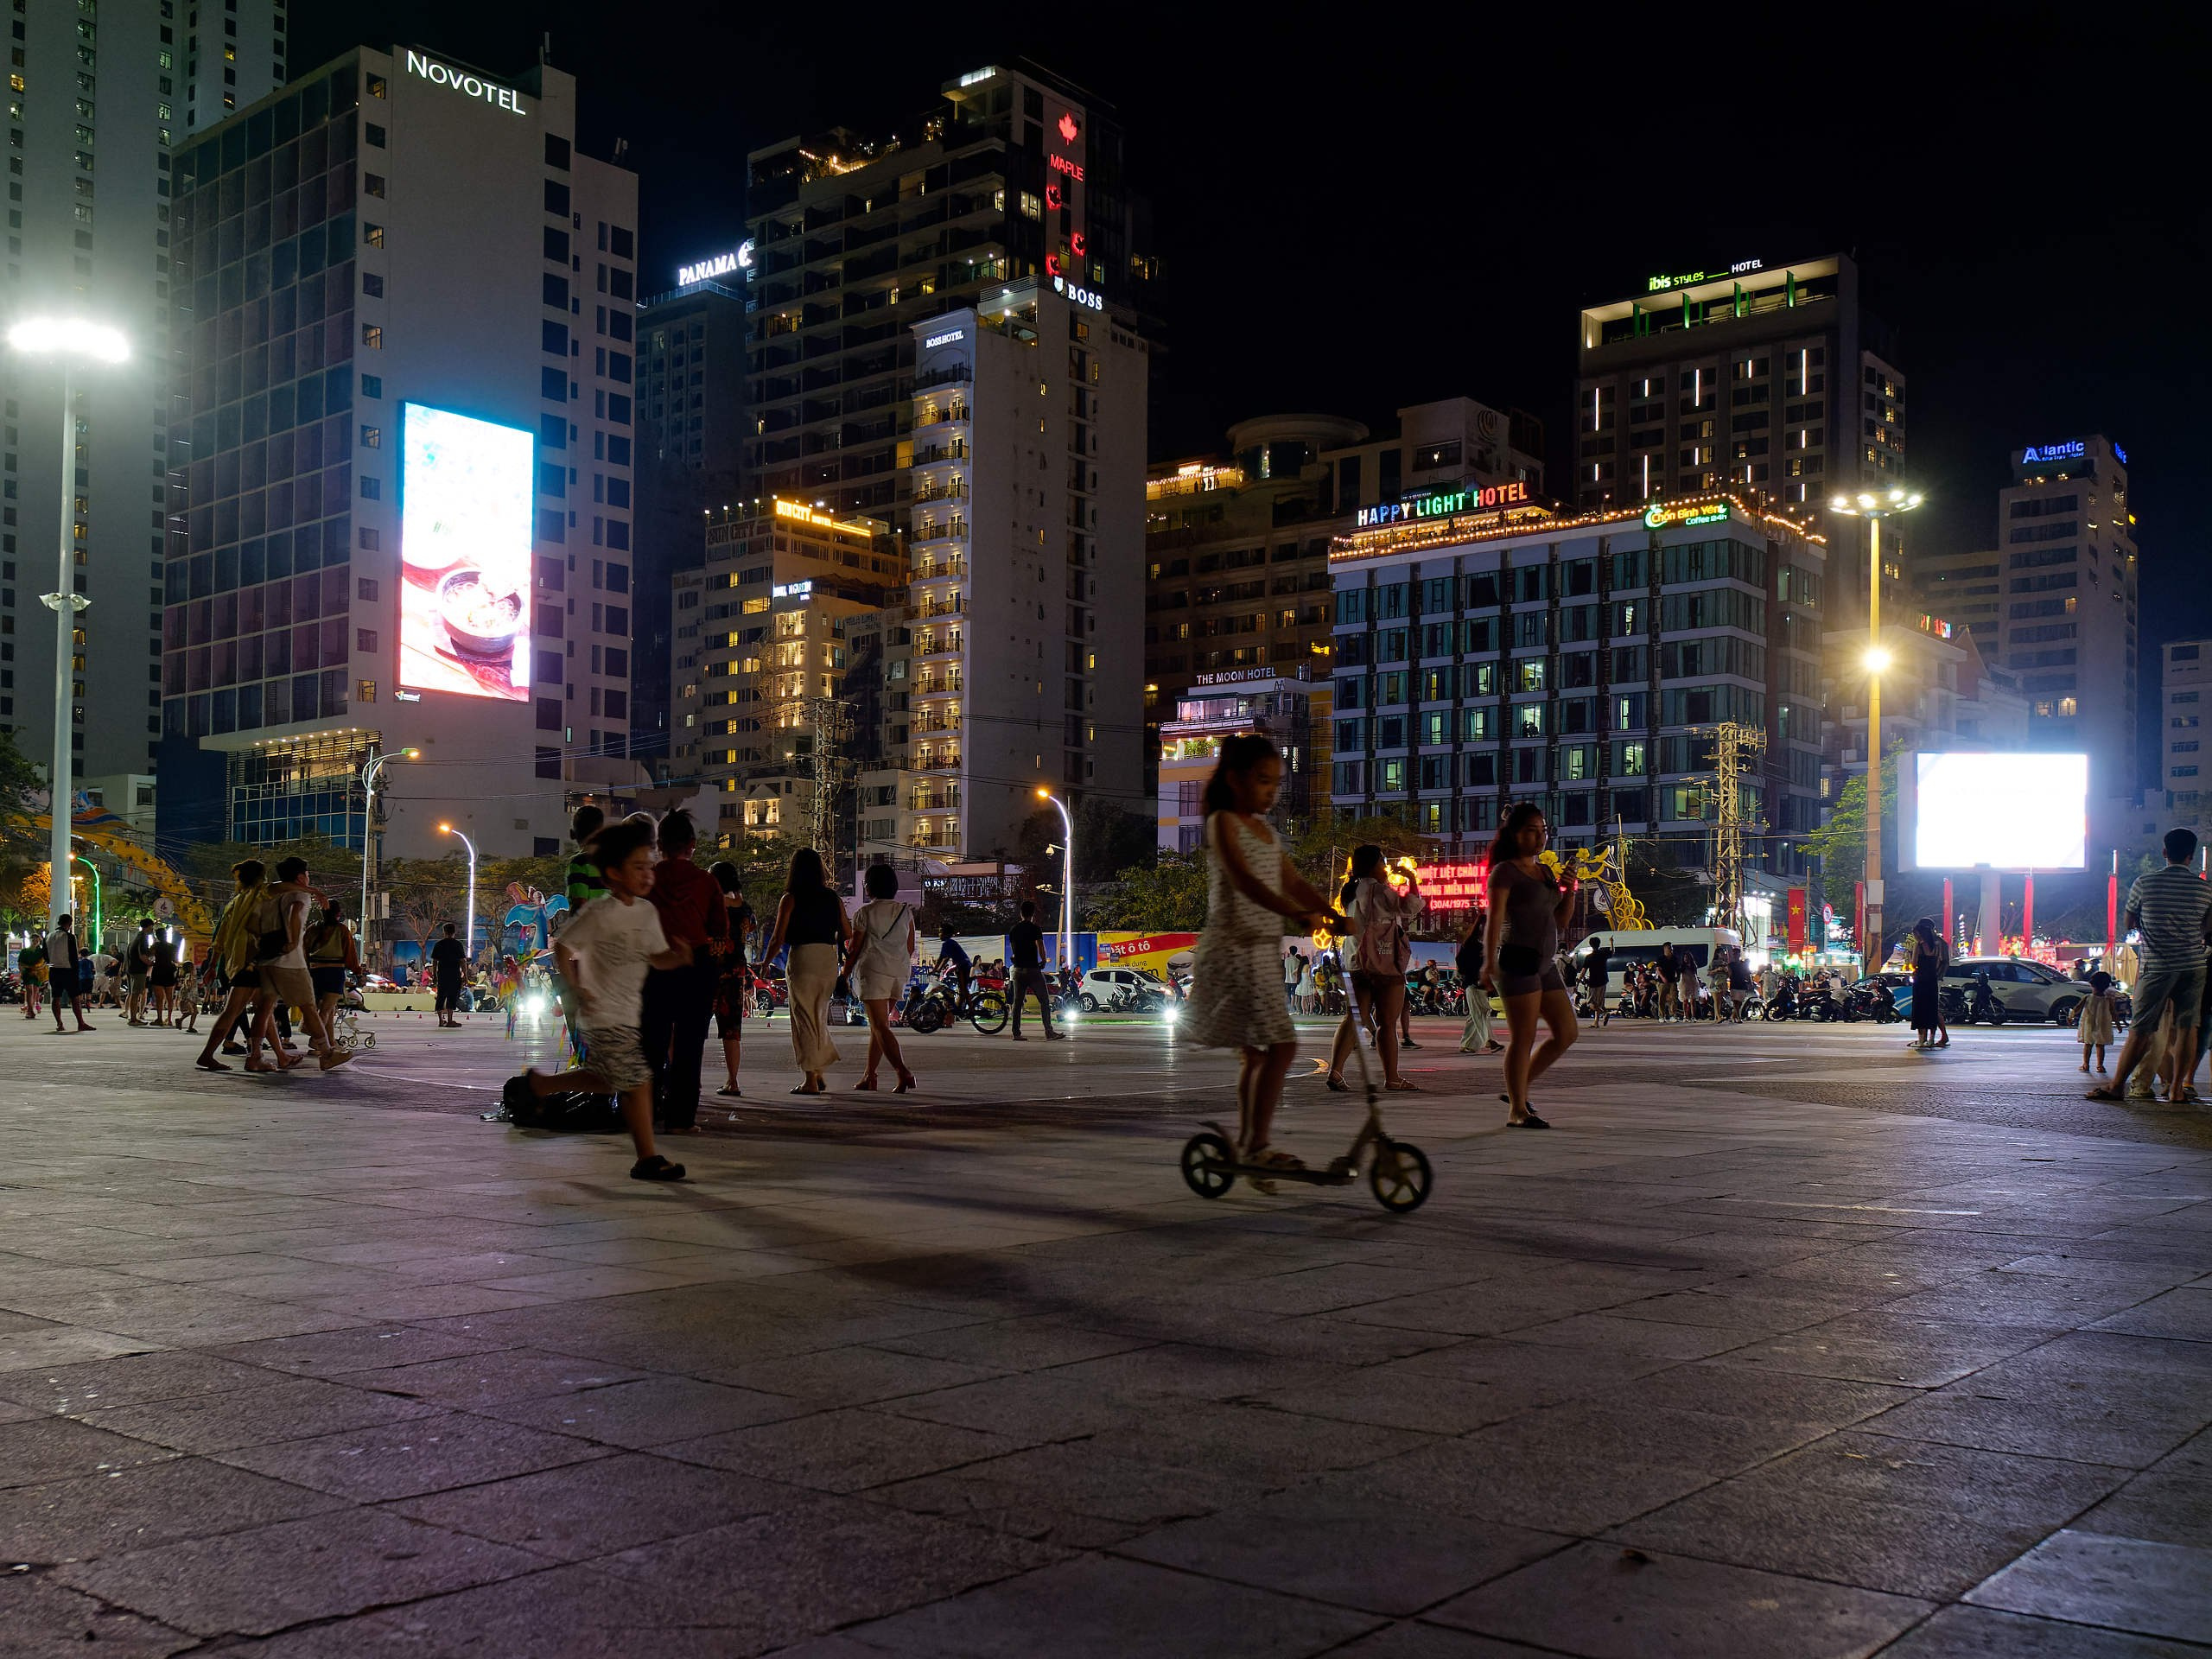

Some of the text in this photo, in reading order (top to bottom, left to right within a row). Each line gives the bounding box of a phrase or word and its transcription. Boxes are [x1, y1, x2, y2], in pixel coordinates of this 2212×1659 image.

[406, 49, 526, 116] NOVOTEL
[1050, 153, 1084, 182] MAPLE
[678, 253, 737, 286] PANAMA
[1649, 275, 1671, 291] ibis
[1731, 258, 1764, 274] HOTEL
[1067, 283, 1103, 312] BOSS
[925, 329, 964, 349] BOSS HOTEL
[776, 499, 792, 518] SUN
[791, 504, 812, 522] CITY
[1357, 481, 1528, 527] HAPPY LIGHT HOTEL
[1685, 515, 1710, 525] Coffee
[1196, 666, 1277, 685] THE MOON HOTEL
[1479, 899, 1490, 908] 30
[1138, 940, 1151, 952] tô
